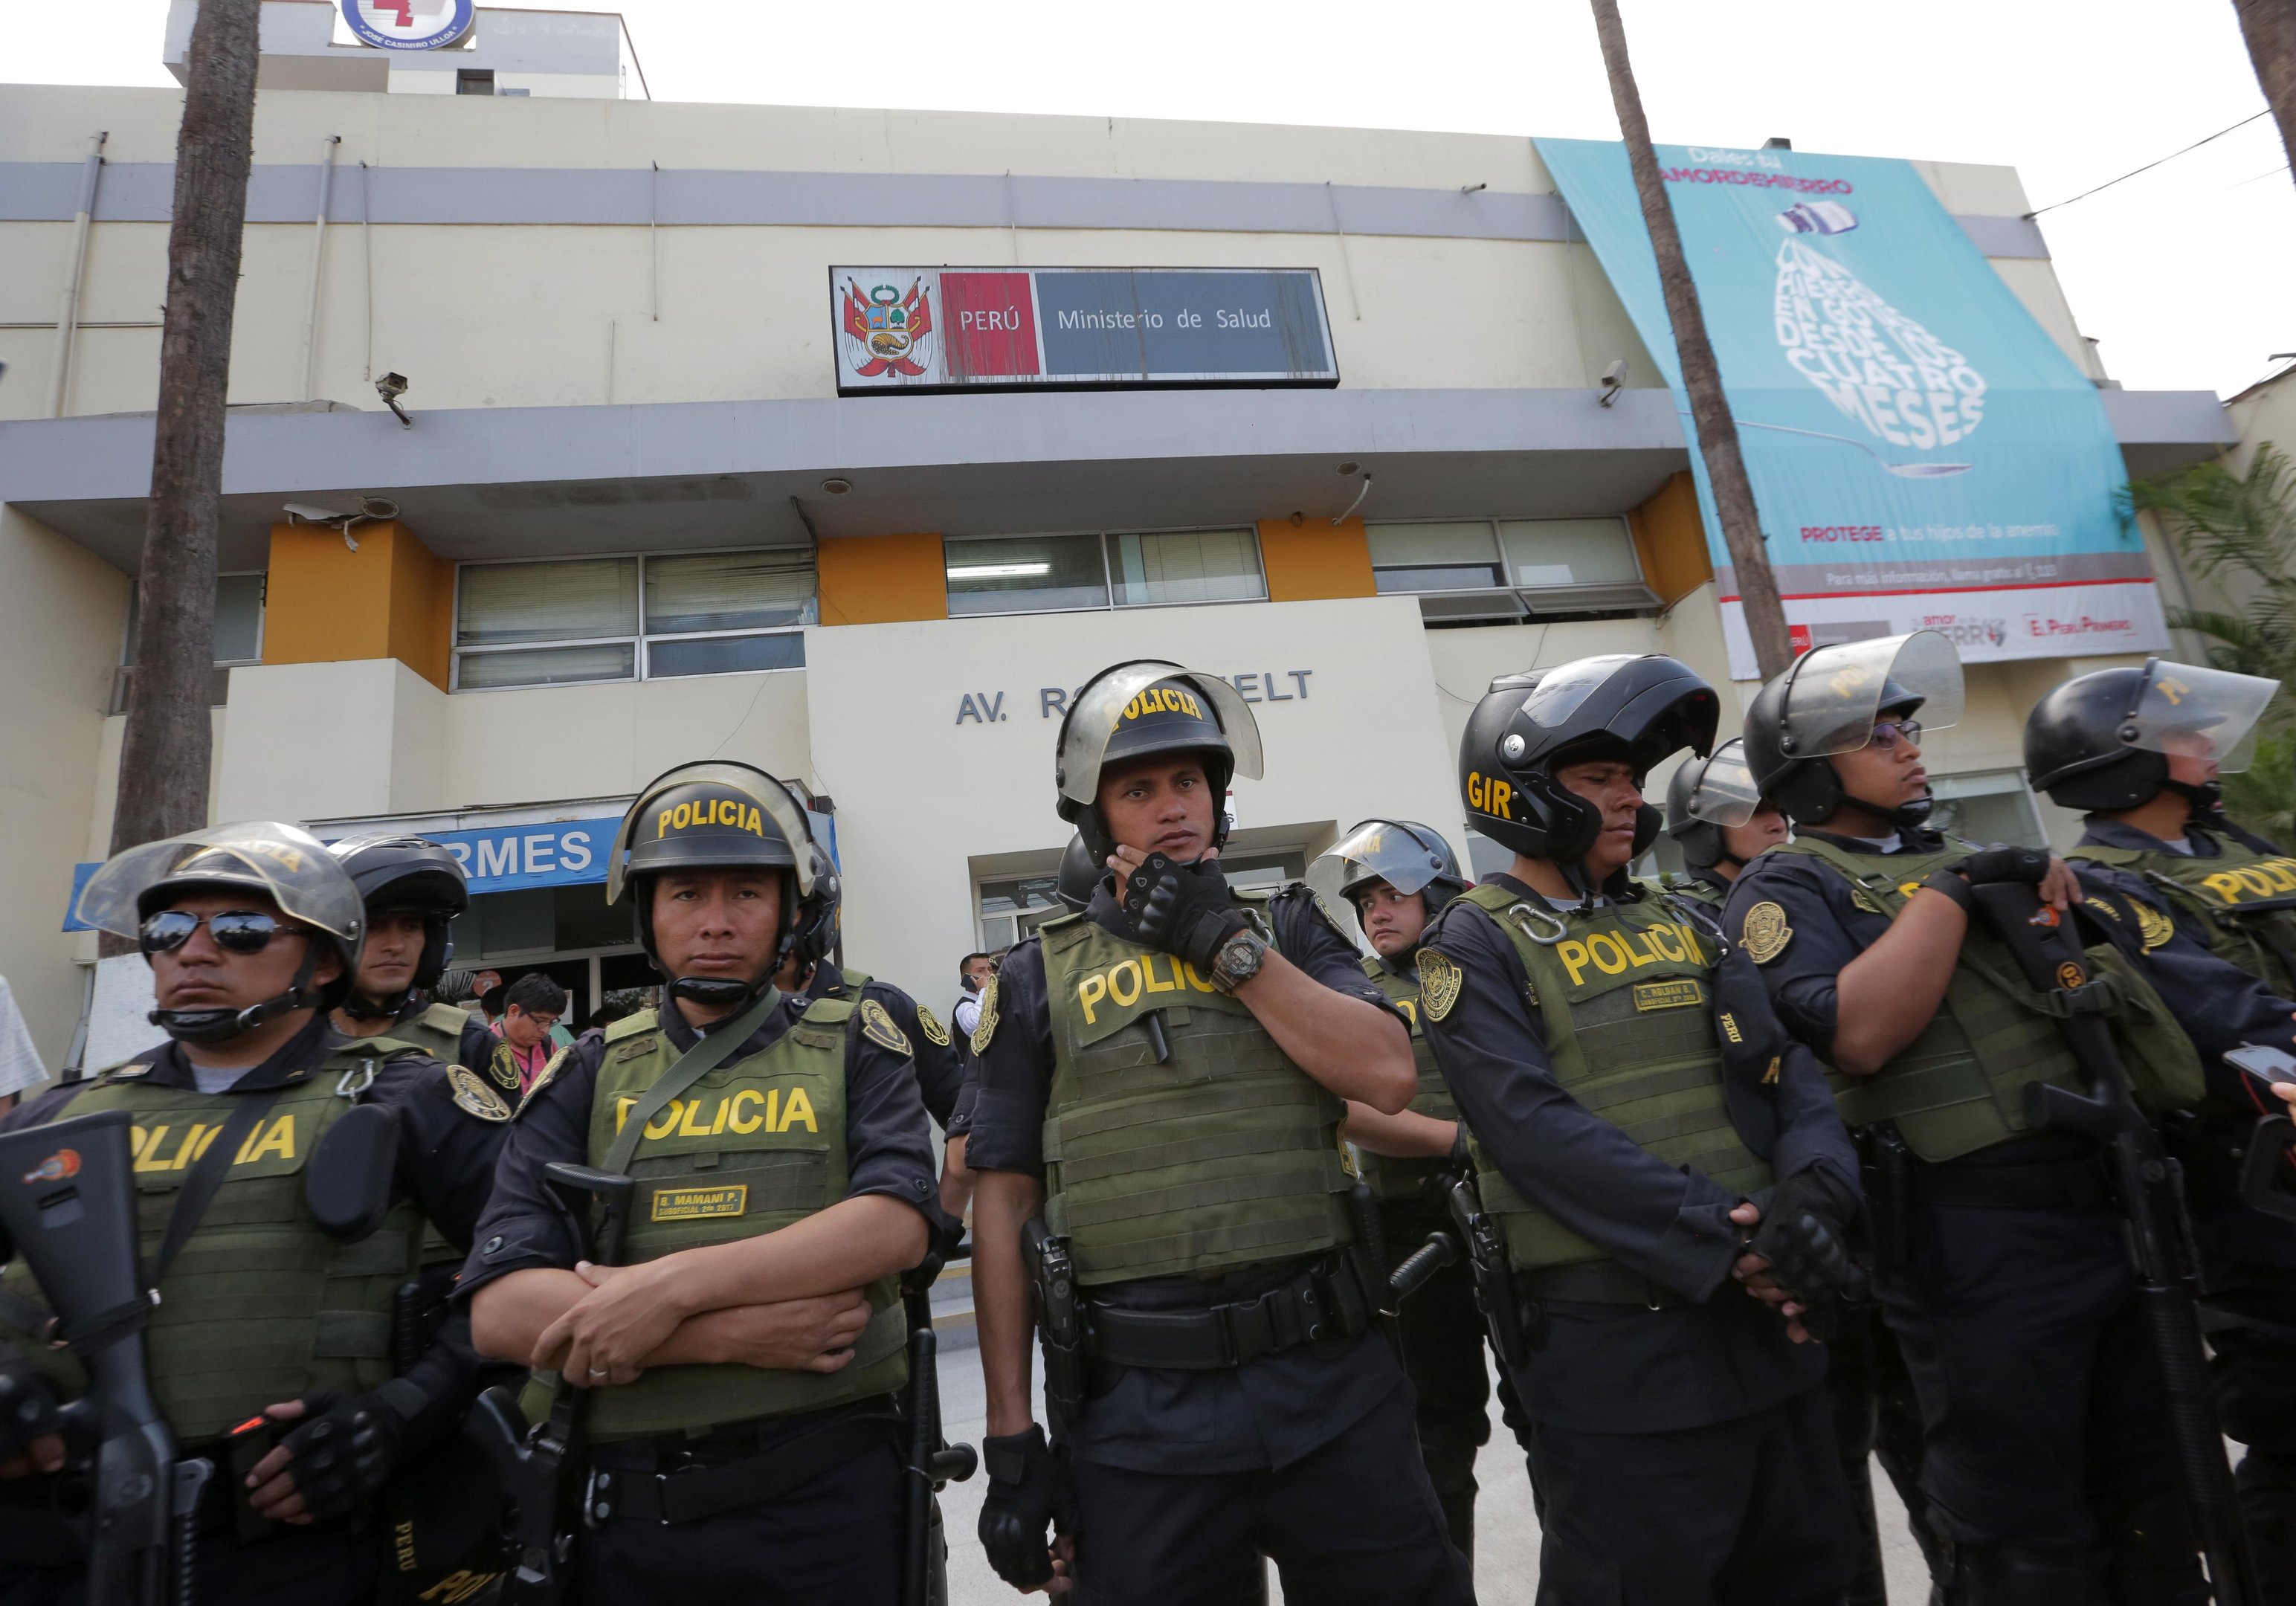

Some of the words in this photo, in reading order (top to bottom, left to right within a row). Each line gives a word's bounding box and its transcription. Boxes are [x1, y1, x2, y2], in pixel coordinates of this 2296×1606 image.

[384, 39, 428, 49] CASIMIRO
[1687, 146, 1754, 167] Dales
[1755, 152, 1783, 170] tu
[960, 305, 1021, 332] PERÚ
[1058, 308, 1164, 329] Ministerio
[1176, 311, 1202, 329] de
[1216, 306, 1272, 330] Salud
[1775, 315, 1899, 364] DESDE
[1786, 346, 1987, 398] CUATRO
[1810, 376, 1986, 450] MESES
[1800, 525, 1883, 543] PROTEGE
[1886, 528, 1896, 541] a
[1899, 526, 1924, 541] tus
[1927, 523, 1964, 543] hijos
[1966, 523, 1986, 539] de
[1987, 522, 2003, 538] la
[2005, 520, 2060, 538] anemia
[1826, 573, 1854, 586] Para
[1855, 572, 1878, 584] más
[1880, 570, 1951, 584] información,
[1923, 614, 1956, 626] amor
[1791, 634, 1810, 647] ERÚ
[955, 690, 1007, 724] AV.
[1468, 772, 1511, 819] GIR
[657, 799, 764, 839] POLICIA
[1555, 923, 1709, 987] POLICIA
[2062, 965, 2083, 989] 03
[1719, 1013, 1744, 1043] PERU
[674, 1193, 724, 1206] MAMANI
[726, 1192, 738, 1202] P.
